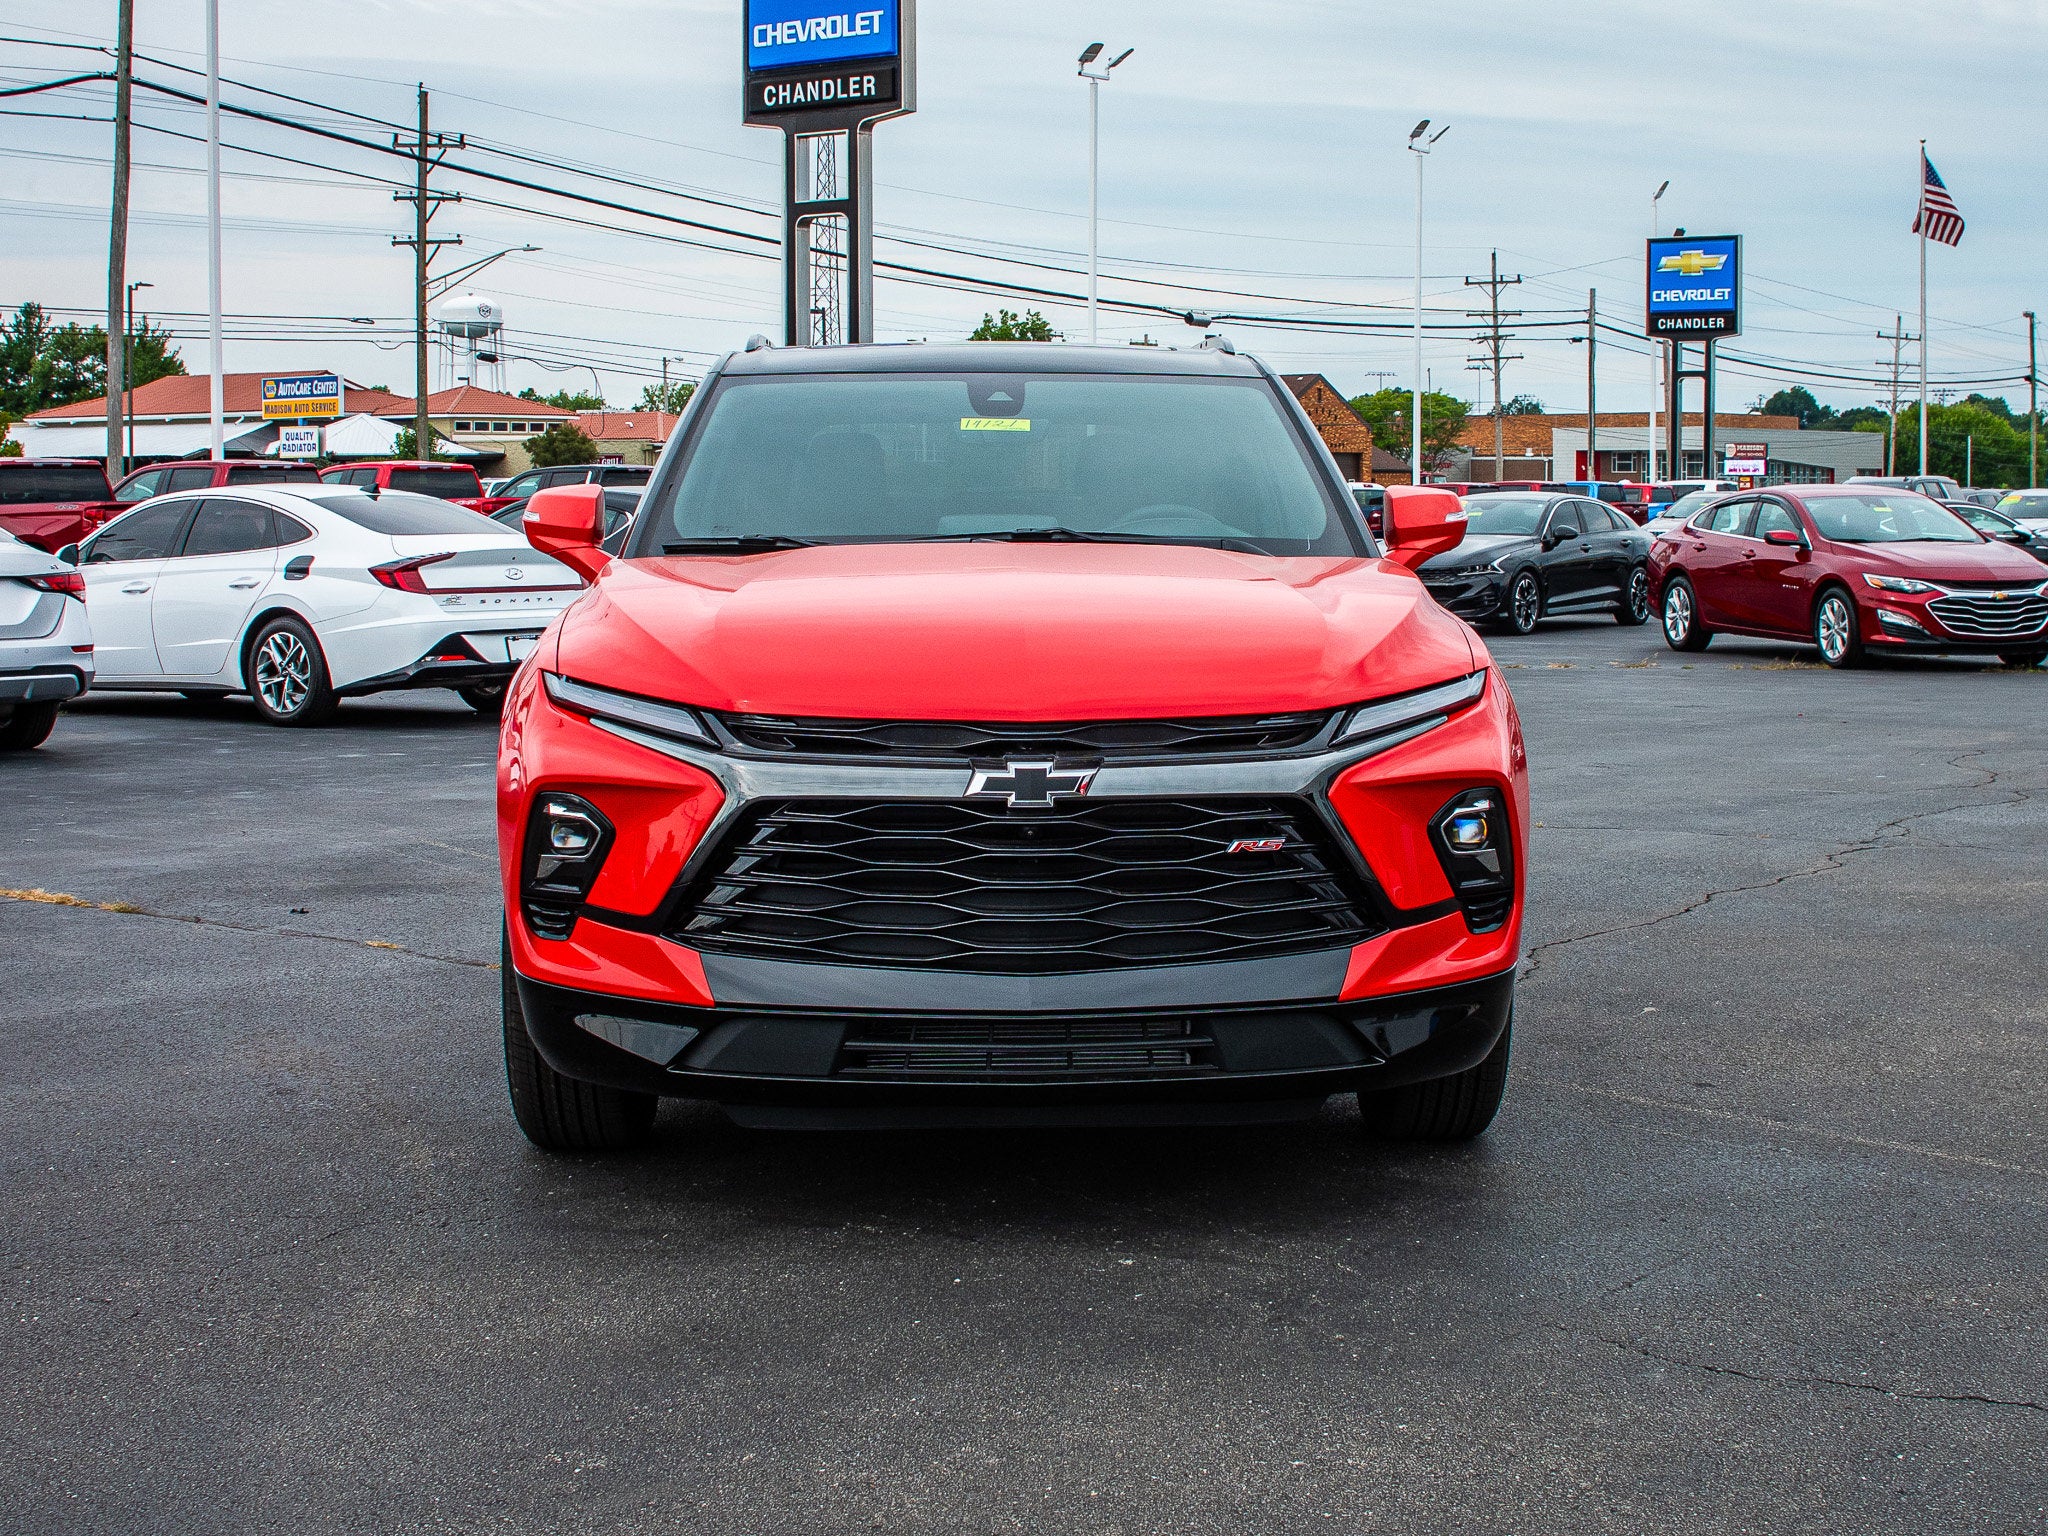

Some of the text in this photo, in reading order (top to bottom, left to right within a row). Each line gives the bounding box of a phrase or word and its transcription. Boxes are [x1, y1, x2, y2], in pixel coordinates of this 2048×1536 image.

[753, 10, 884, 48] CHEVROLET
[763, 75, 876, 107] CHANDLER
[1652, 288, 1731, 302] CHEVROLET
[1658, 317, 1725, 330] CHANDLER
[313, 380, 337, 395] CENTER
[264, 401, 337, 415] MADISON AUTO SERVICE
[285, 431, 314, 441] QUALITY
[282, 443, 317, 453] RADIATOR
[479, 596, 554, 605] SONATA
[1226, 838, 1286, 853] RS
